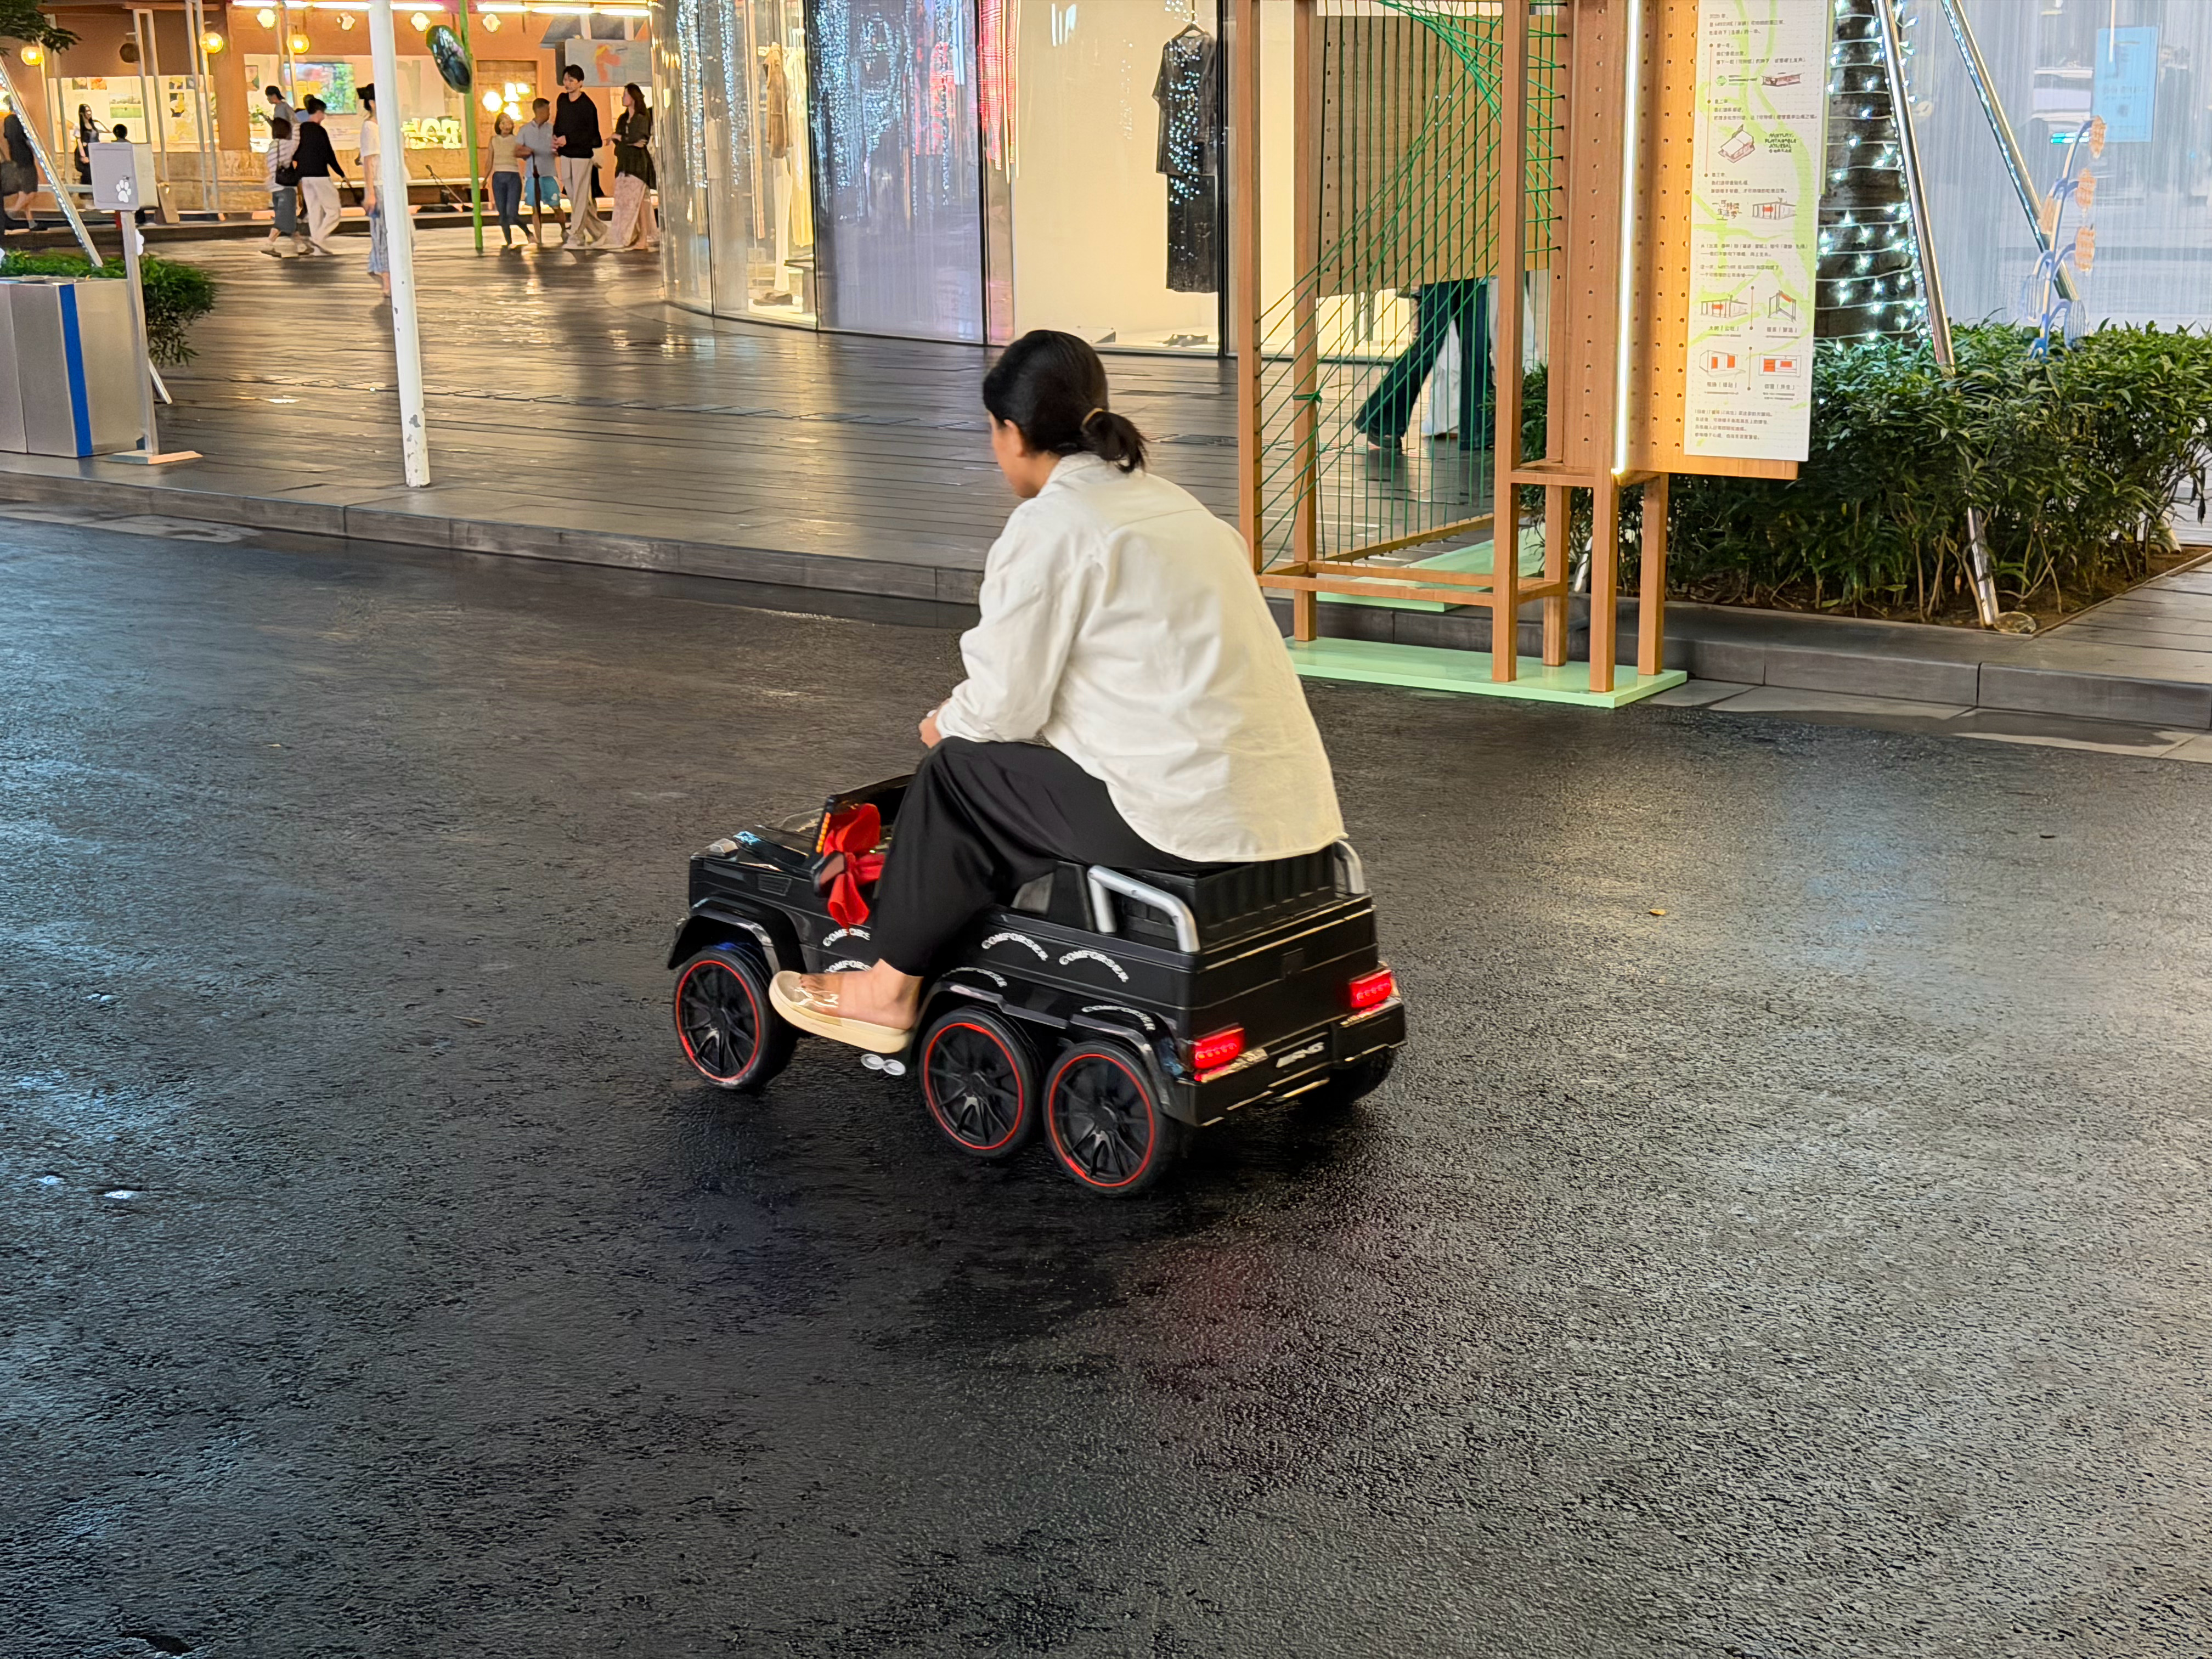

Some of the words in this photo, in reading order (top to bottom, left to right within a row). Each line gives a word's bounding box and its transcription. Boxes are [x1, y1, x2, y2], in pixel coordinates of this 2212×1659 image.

[822, 928, 871, 947] COMFORS
[981, 933, 1048, 961] COMFORSER
[1059, 950, 1129, 983] COMFORSER
